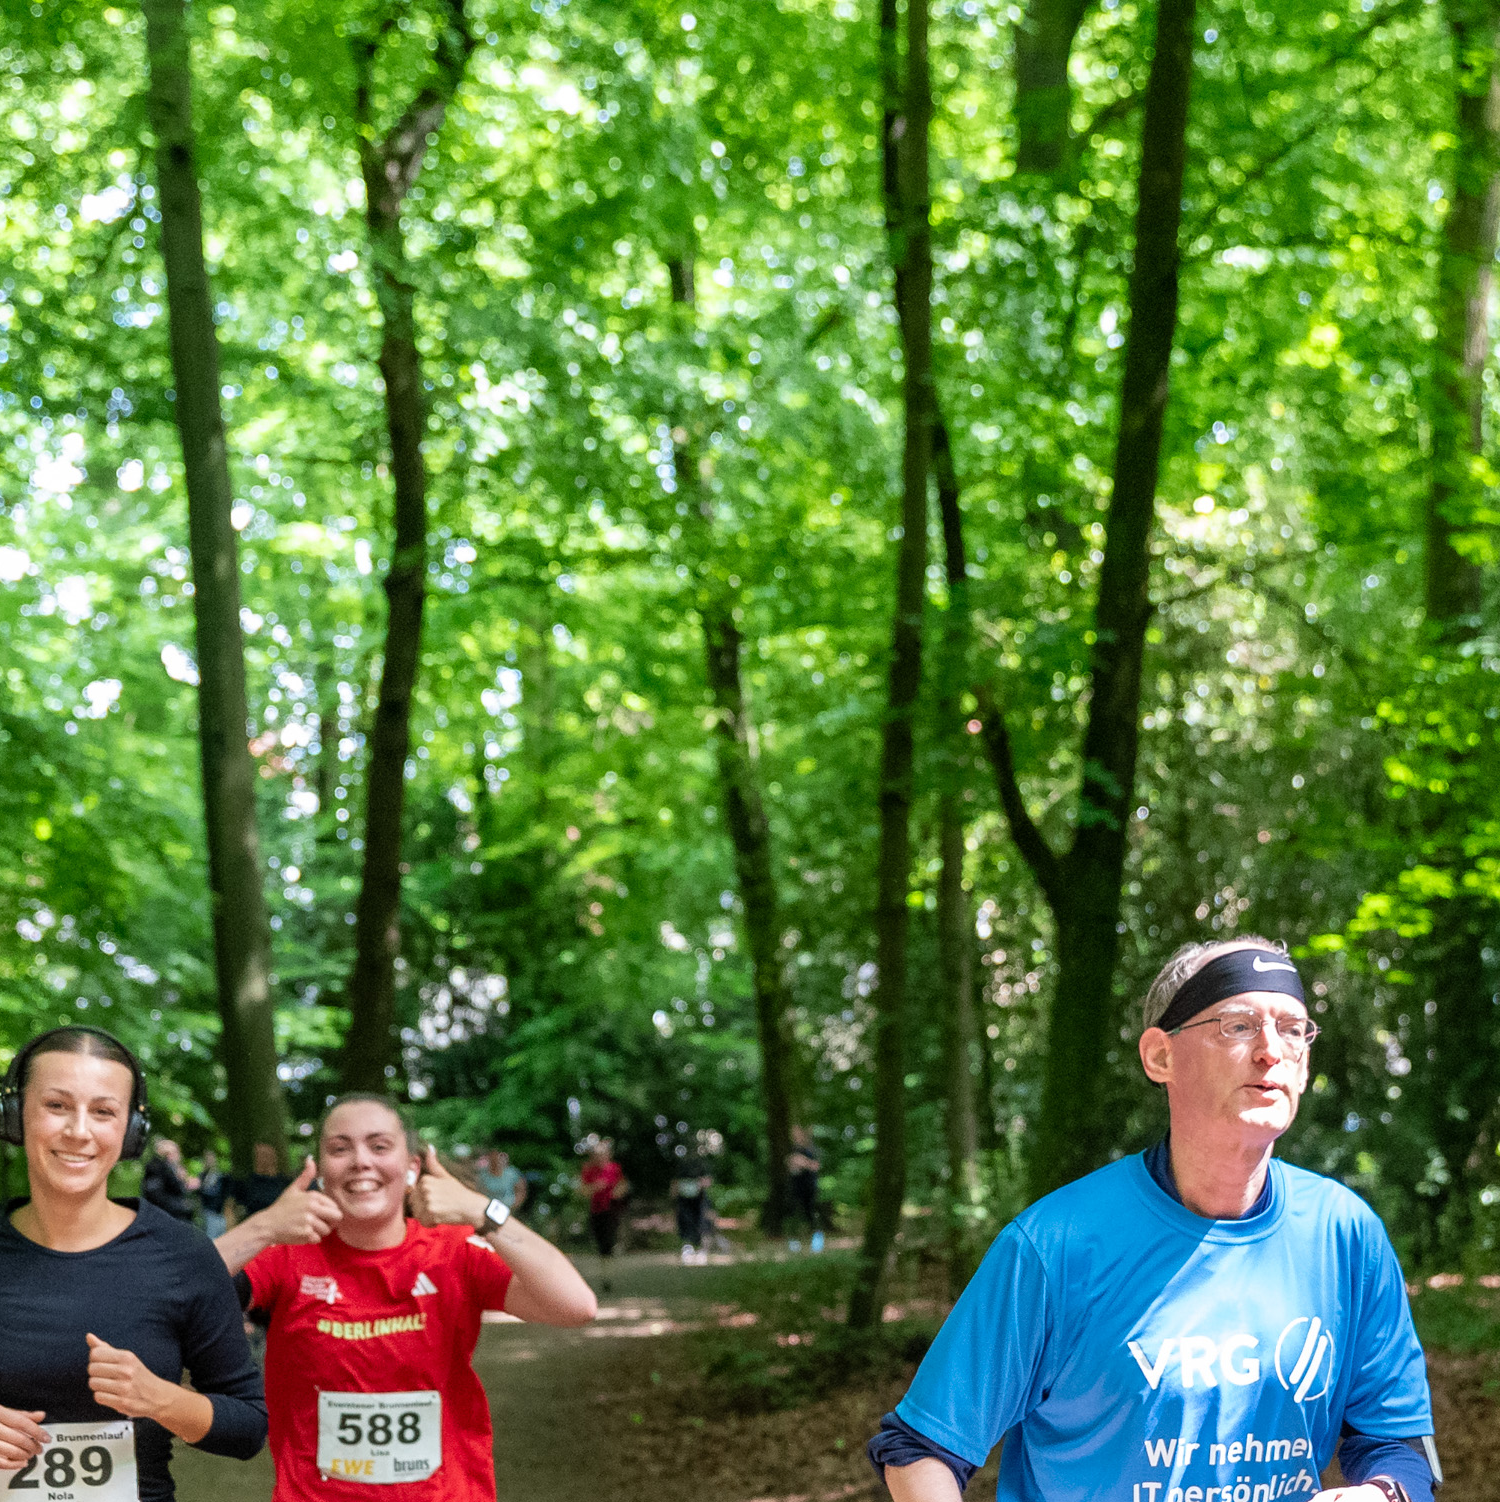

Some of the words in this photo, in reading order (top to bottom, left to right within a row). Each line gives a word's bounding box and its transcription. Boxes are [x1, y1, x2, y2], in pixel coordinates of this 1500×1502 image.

[1127, 1333, 1261, 1392] VRG
[56, 1432, 124, 1443] Brunnenlauf
[337, 1411, 421, 1446] 588
[1144, 1437, 1201, 1468] Wir
[8, 1445, 113, 1489] 289
[330, 1458, 376, 1476] EWE
[393, 1457, 430, 1473] bruns
[47, 1492, 75, 1501] Nola
